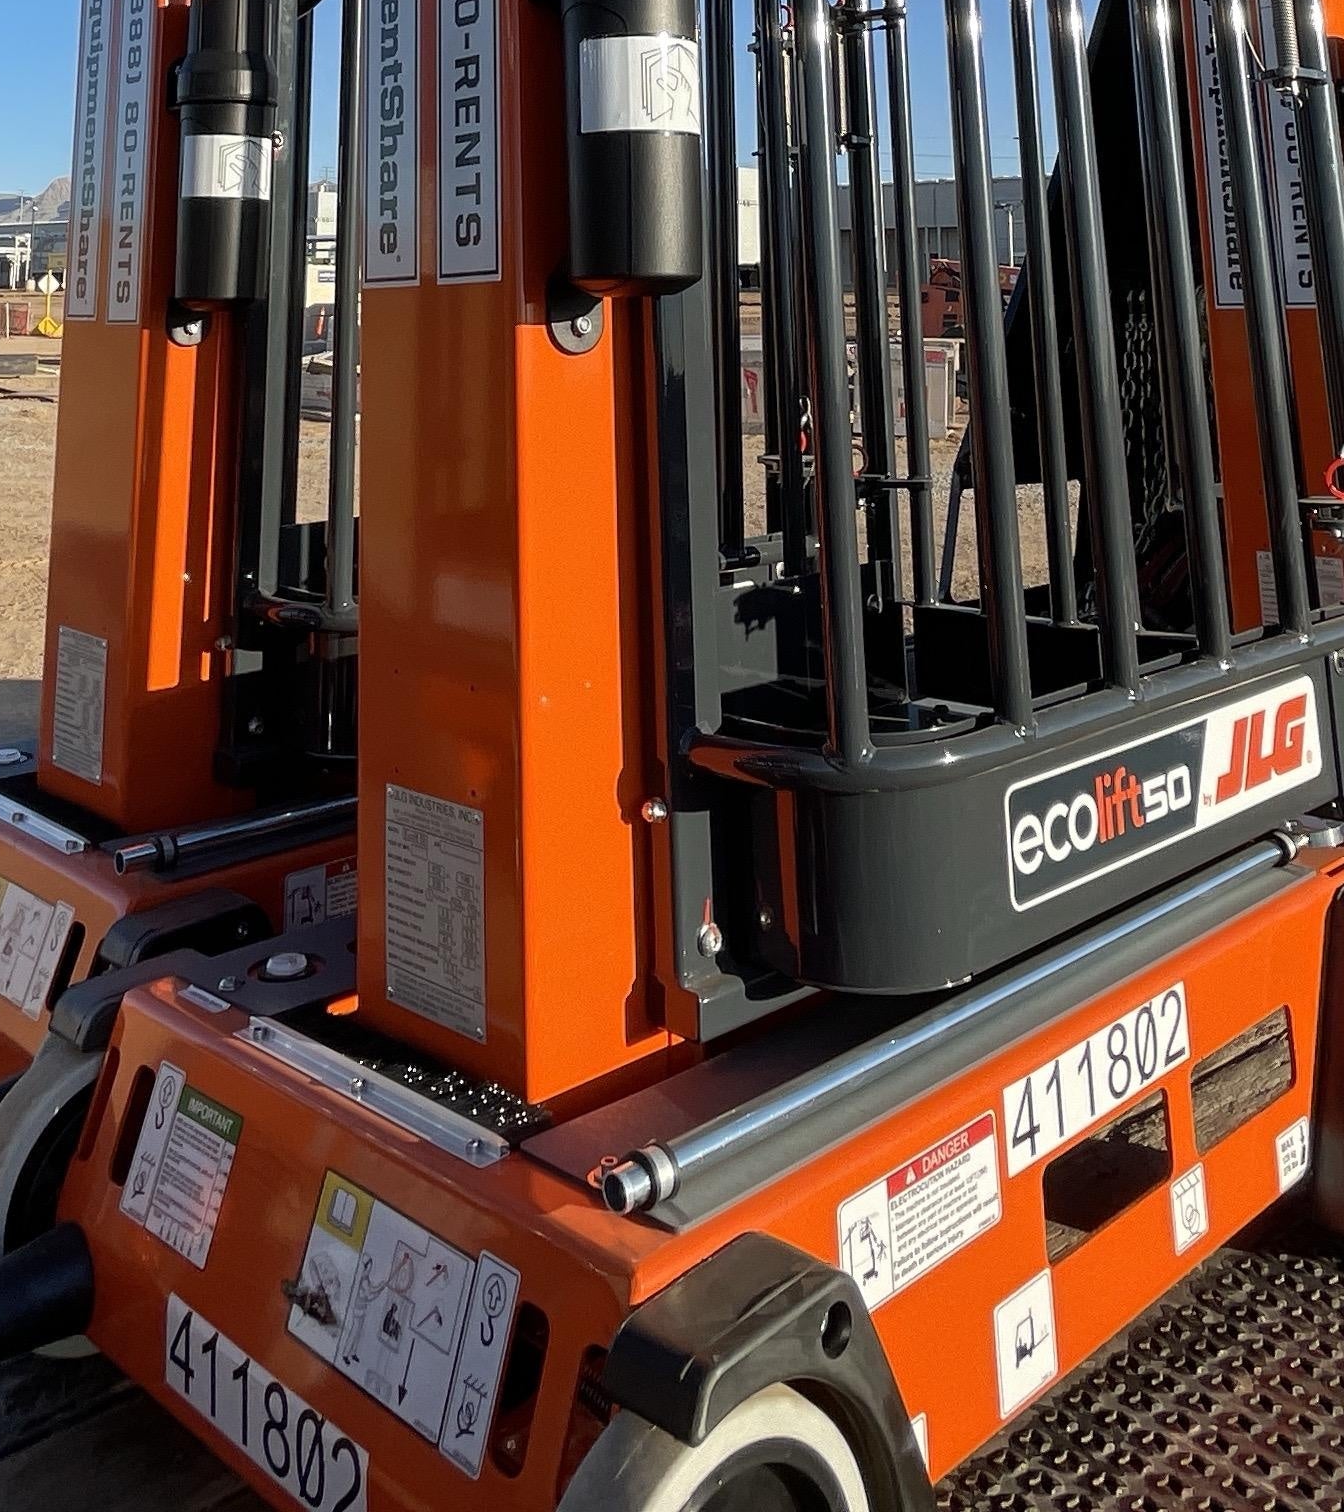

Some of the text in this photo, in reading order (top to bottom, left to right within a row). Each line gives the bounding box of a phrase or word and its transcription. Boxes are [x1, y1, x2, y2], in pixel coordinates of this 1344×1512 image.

[115, 100, 140, 305] 80-RENTS
[1012, 763, 1192, 875] ecolift50
[1215, 692, 1307, 805] JLG
[187, 1097, 234, 1135] IMPORTANT
[921, 1132, 970, 1174] DANGER
[1012, 989, 1186, 1157] 411802
[890, 1170, 945, 1212] ELECTROCUTION
[945, 1152, 971, 1176] HAZARD
[169, 1310, 362, 1512] 411802
